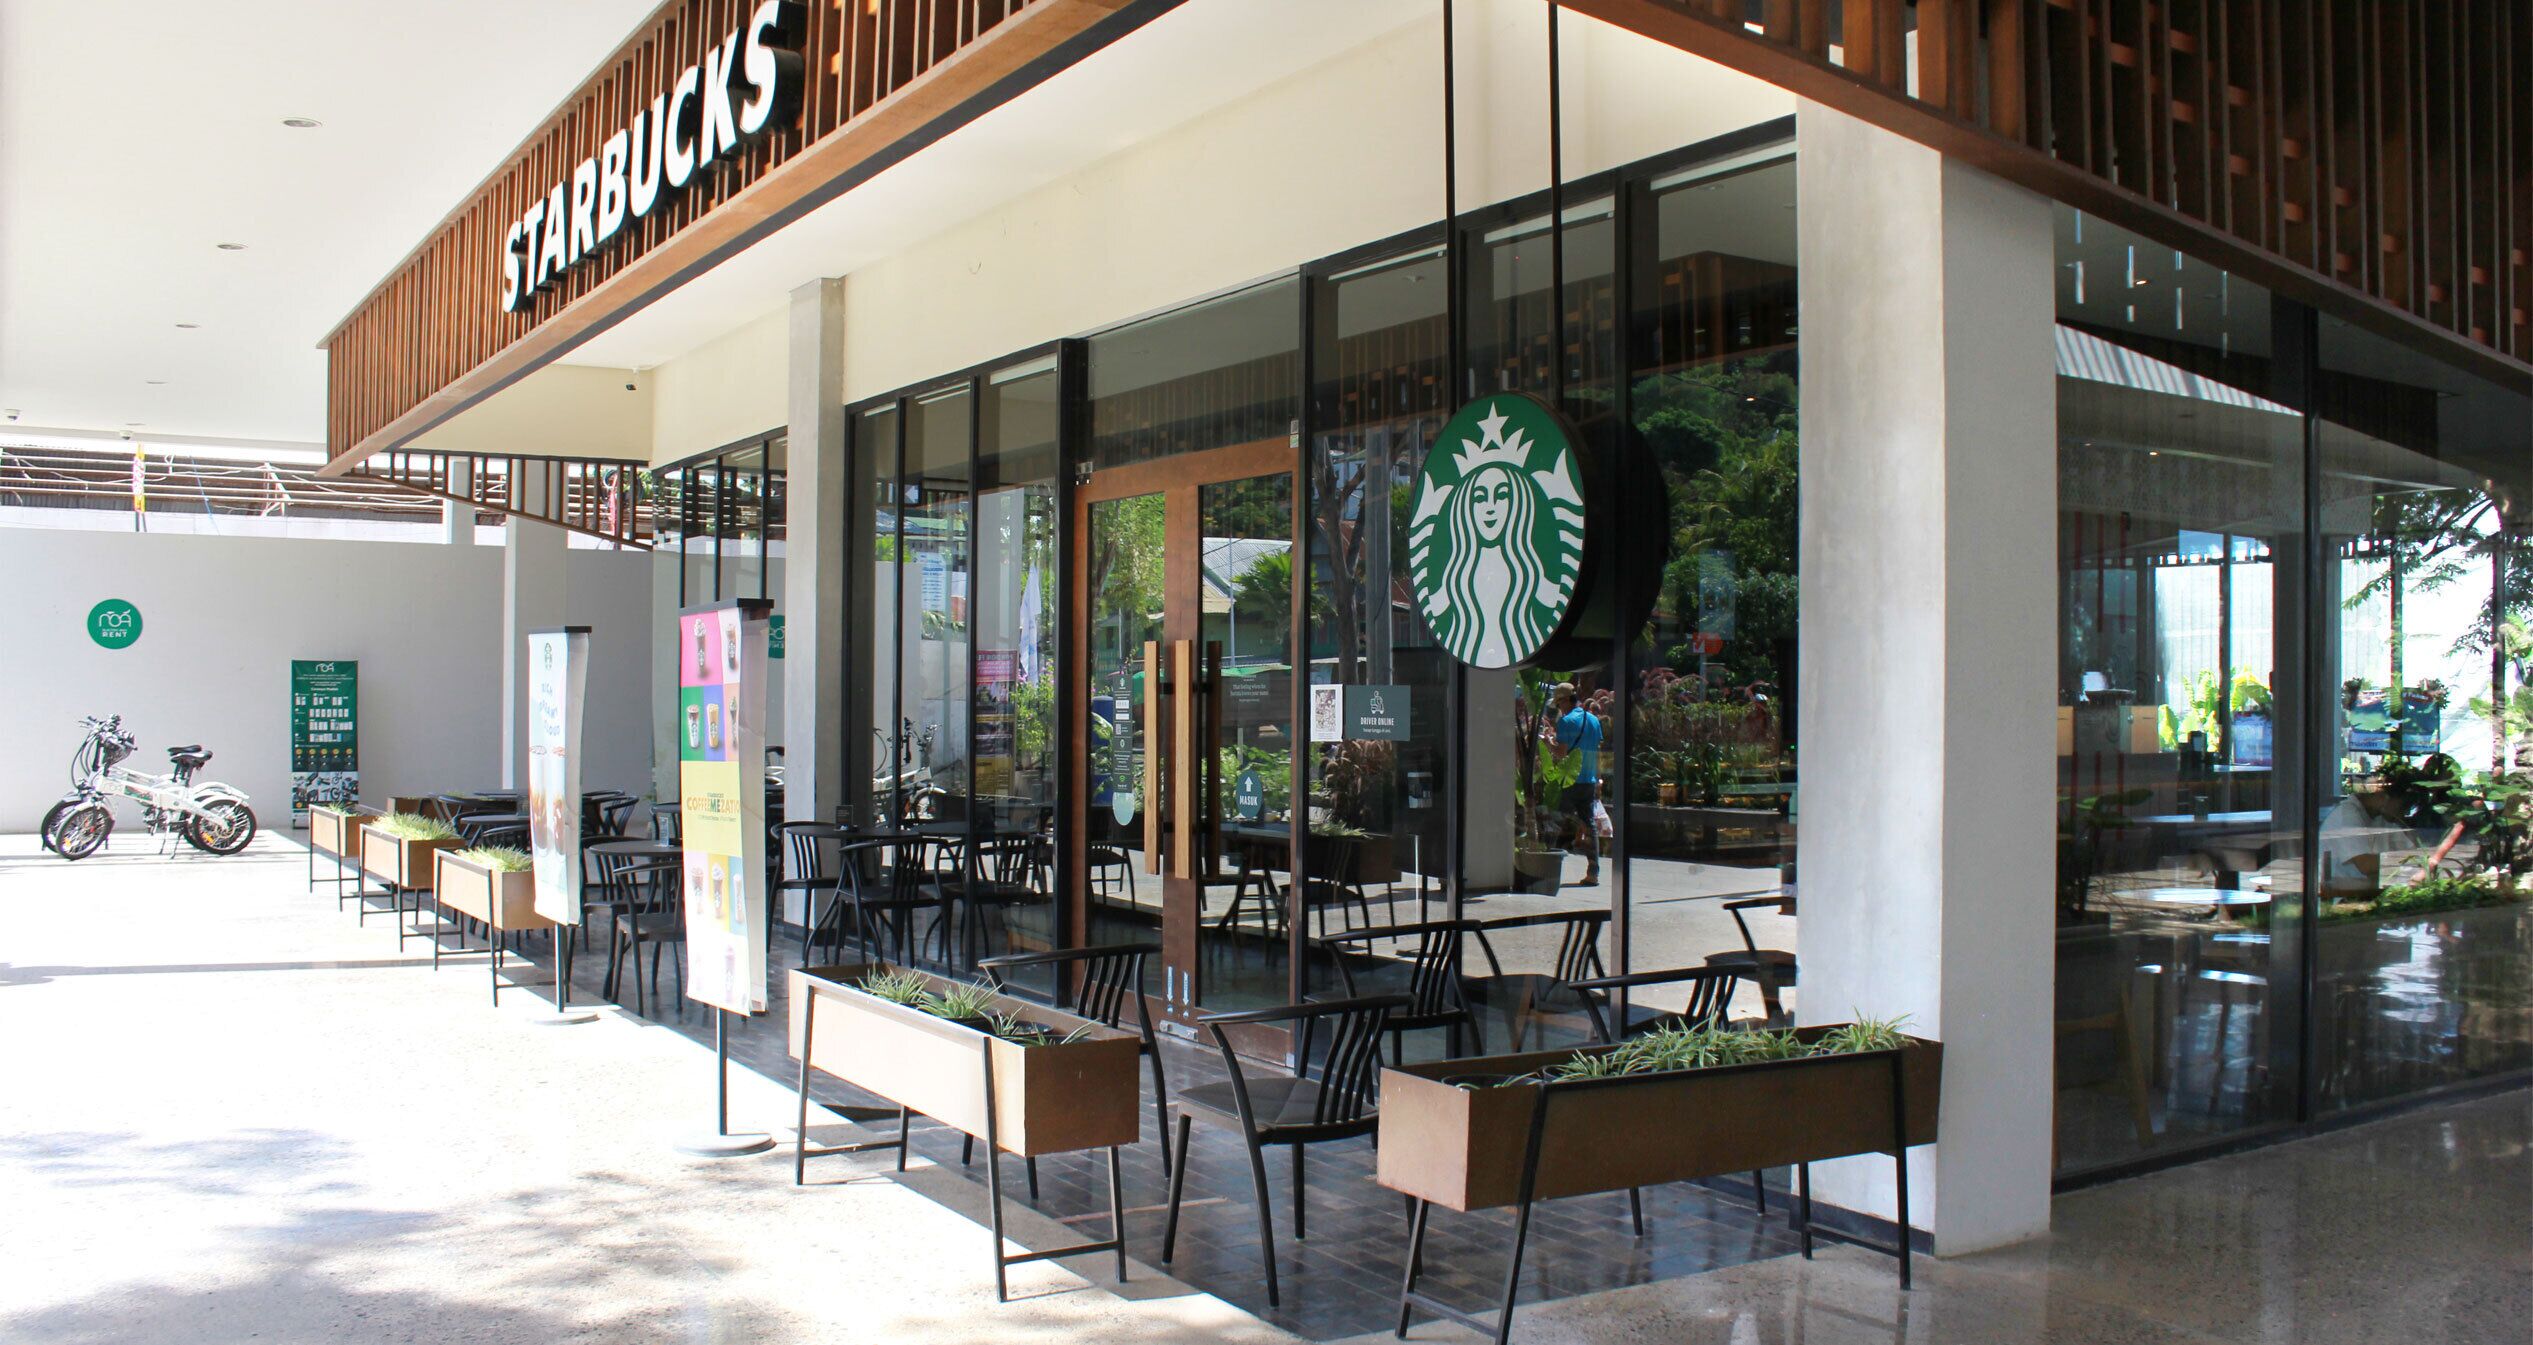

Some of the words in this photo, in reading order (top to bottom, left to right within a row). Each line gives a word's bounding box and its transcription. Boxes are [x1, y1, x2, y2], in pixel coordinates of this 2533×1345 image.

[503, 0, 780, 313] STARBUCKS
[1360, 716, 1377, 725] DRIVER
[1239, 795, 1258, 806] MASUK
